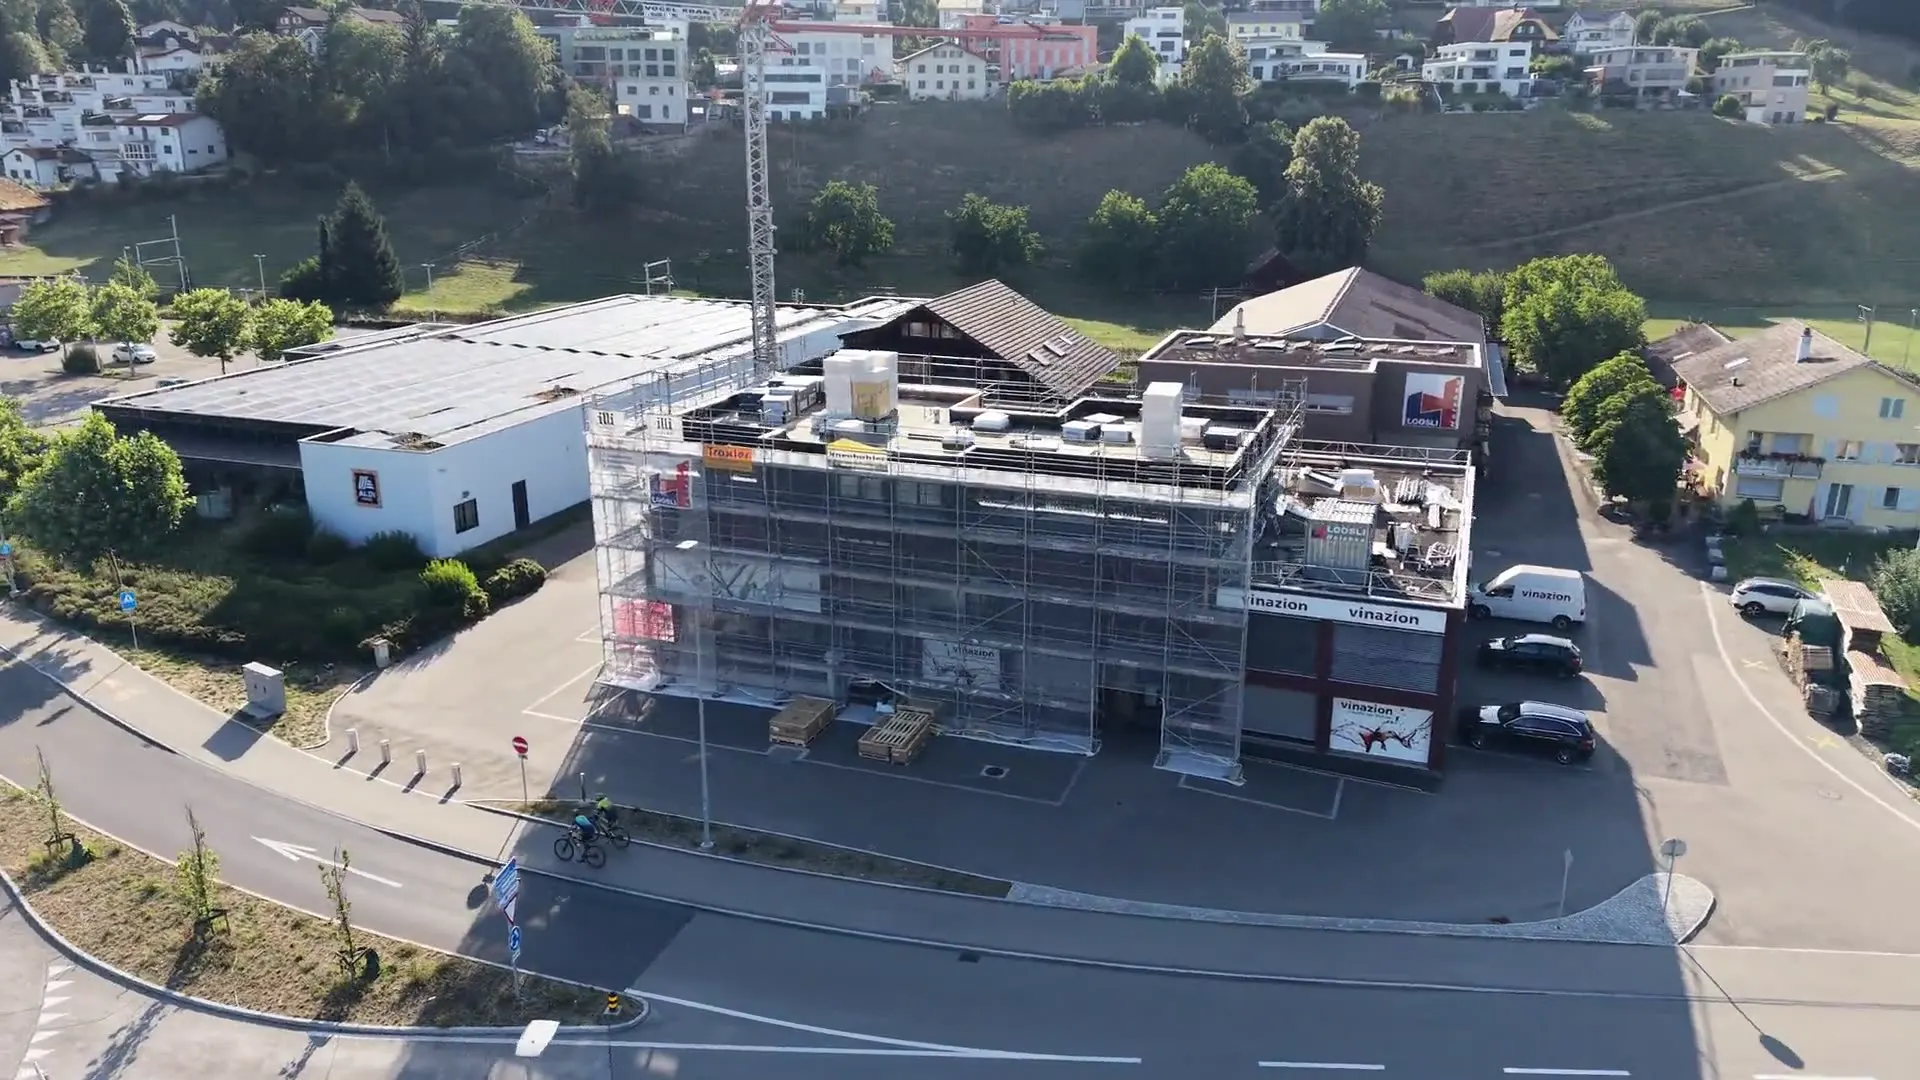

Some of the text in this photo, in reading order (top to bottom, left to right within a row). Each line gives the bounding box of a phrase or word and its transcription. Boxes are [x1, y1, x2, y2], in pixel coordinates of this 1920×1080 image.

[1407, 418, 1439, 426] LOOSLI
[1327, 525, 1366, 536] LOOSLI
[1521, 589, 1572, 602] vinazion
[1349, 606, 1420, 626] vinazion
[953, 645, 995, 658] vnazion
[1340, 701, 1393, 716] vinazion
